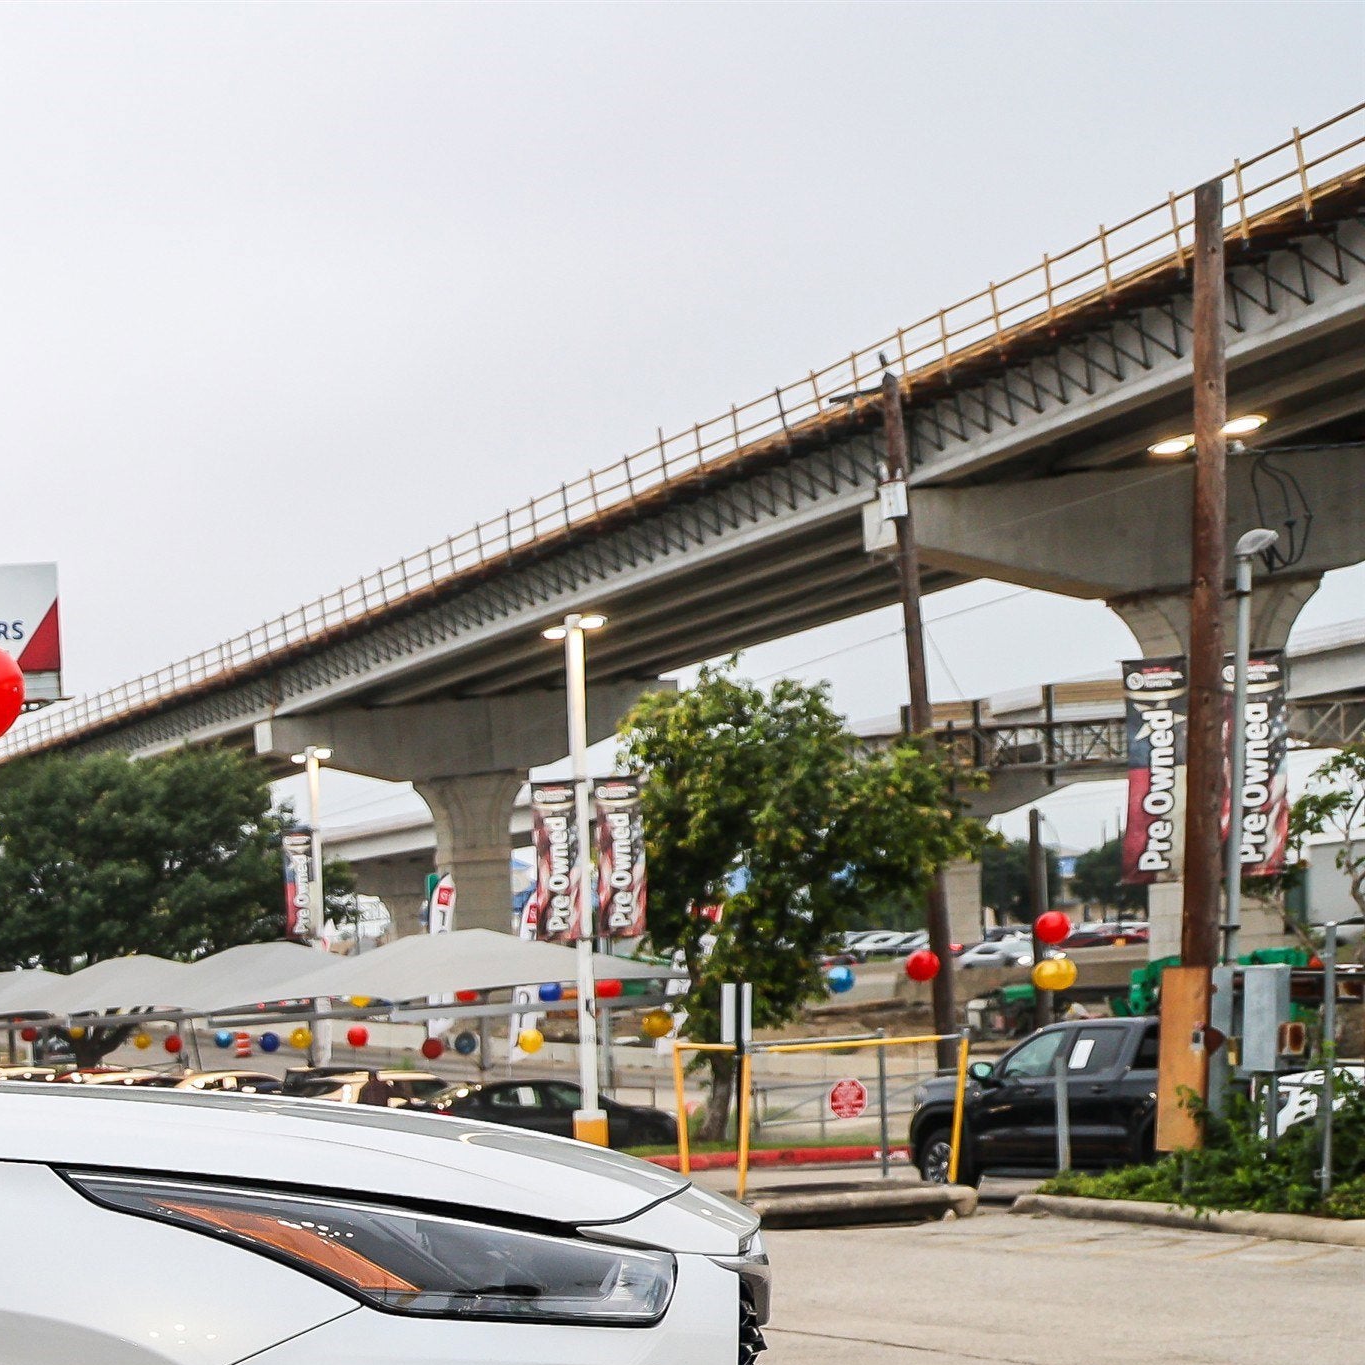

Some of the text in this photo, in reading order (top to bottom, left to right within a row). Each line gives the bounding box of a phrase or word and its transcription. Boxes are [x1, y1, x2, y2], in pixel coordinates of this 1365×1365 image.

[1142, 709, 1175, 815] Owned
[543, 816, 569, 891] Owned
[606, 813, 632, 889] Owned
[1138, 820, 1173, 871] Pre
[1239, 813, 1267, 863] Pre
[547, 895, 570, 932] Pre
[609, 891, 633, 927] Pre
